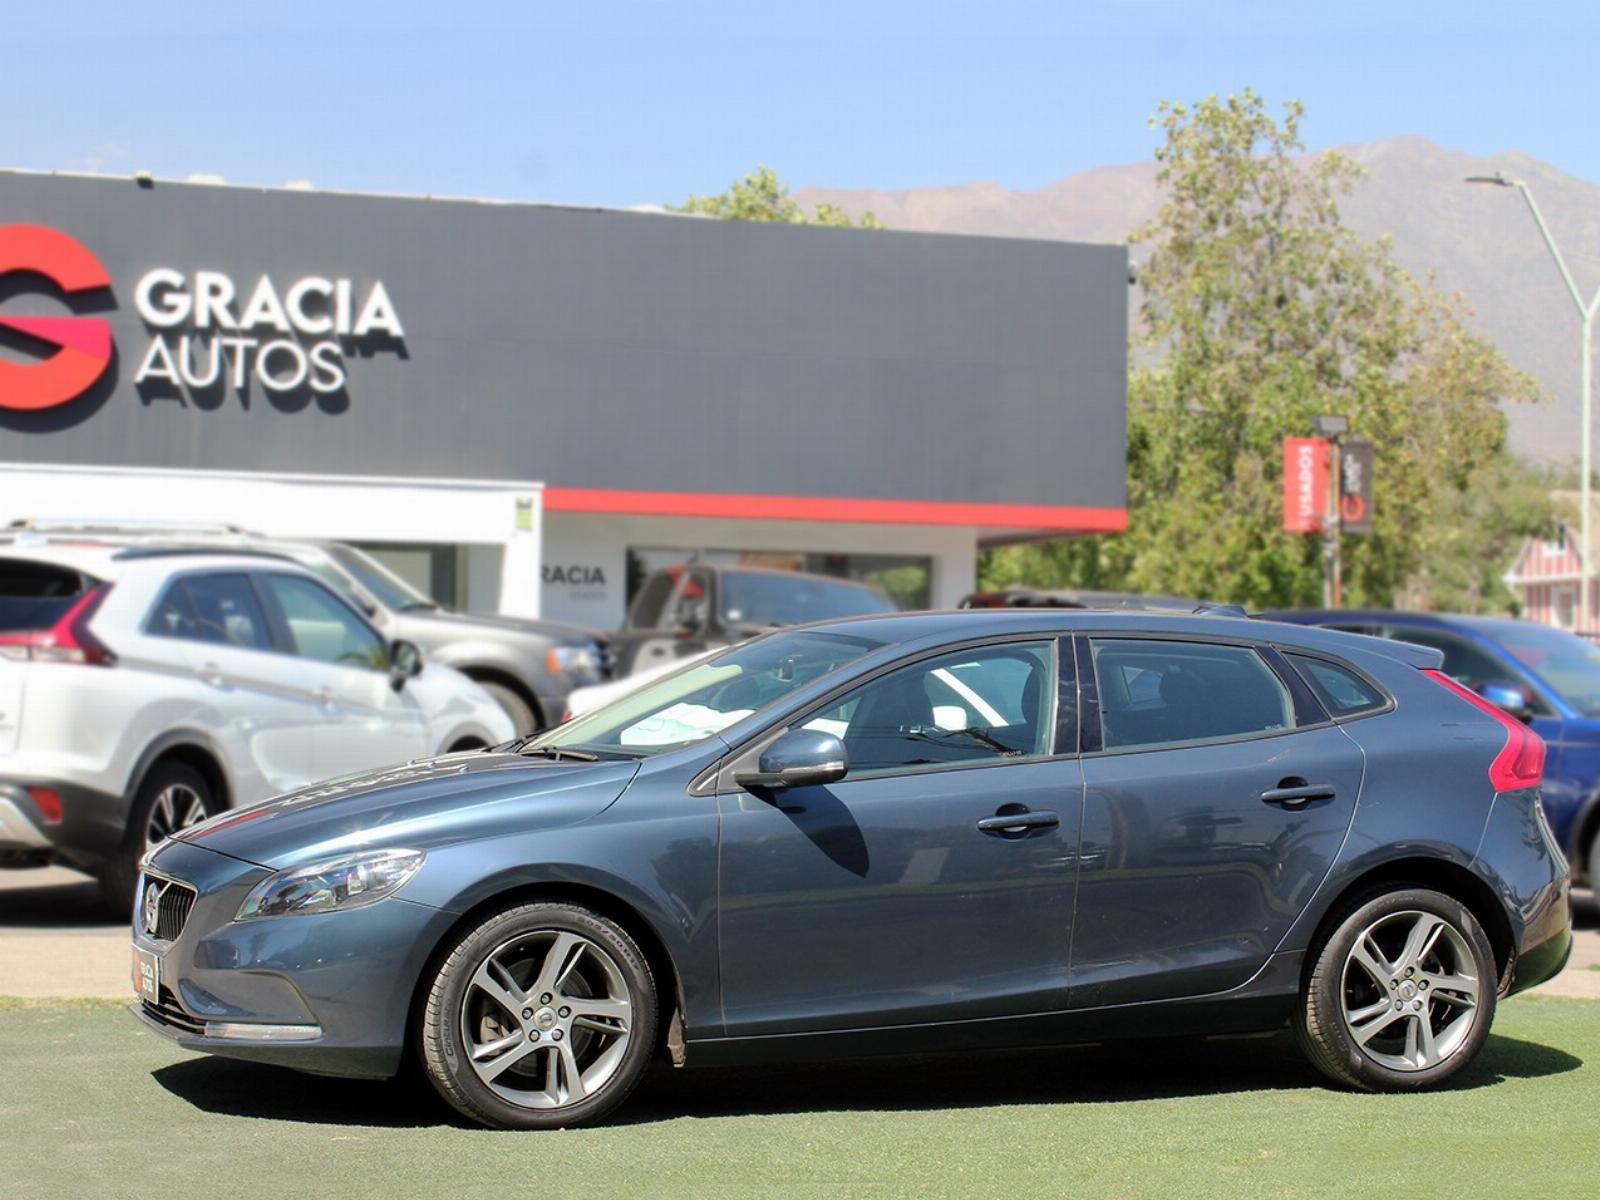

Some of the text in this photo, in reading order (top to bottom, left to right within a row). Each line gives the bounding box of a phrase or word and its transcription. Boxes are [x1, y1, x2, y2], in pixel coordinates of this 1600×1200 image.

[134, 268, 406, 337] GRACIA
[134, 333, 347, 393] AUTOS
[1297, 444, 1314, 518] USADOS
[541, 565, 607, 585] RACIA
